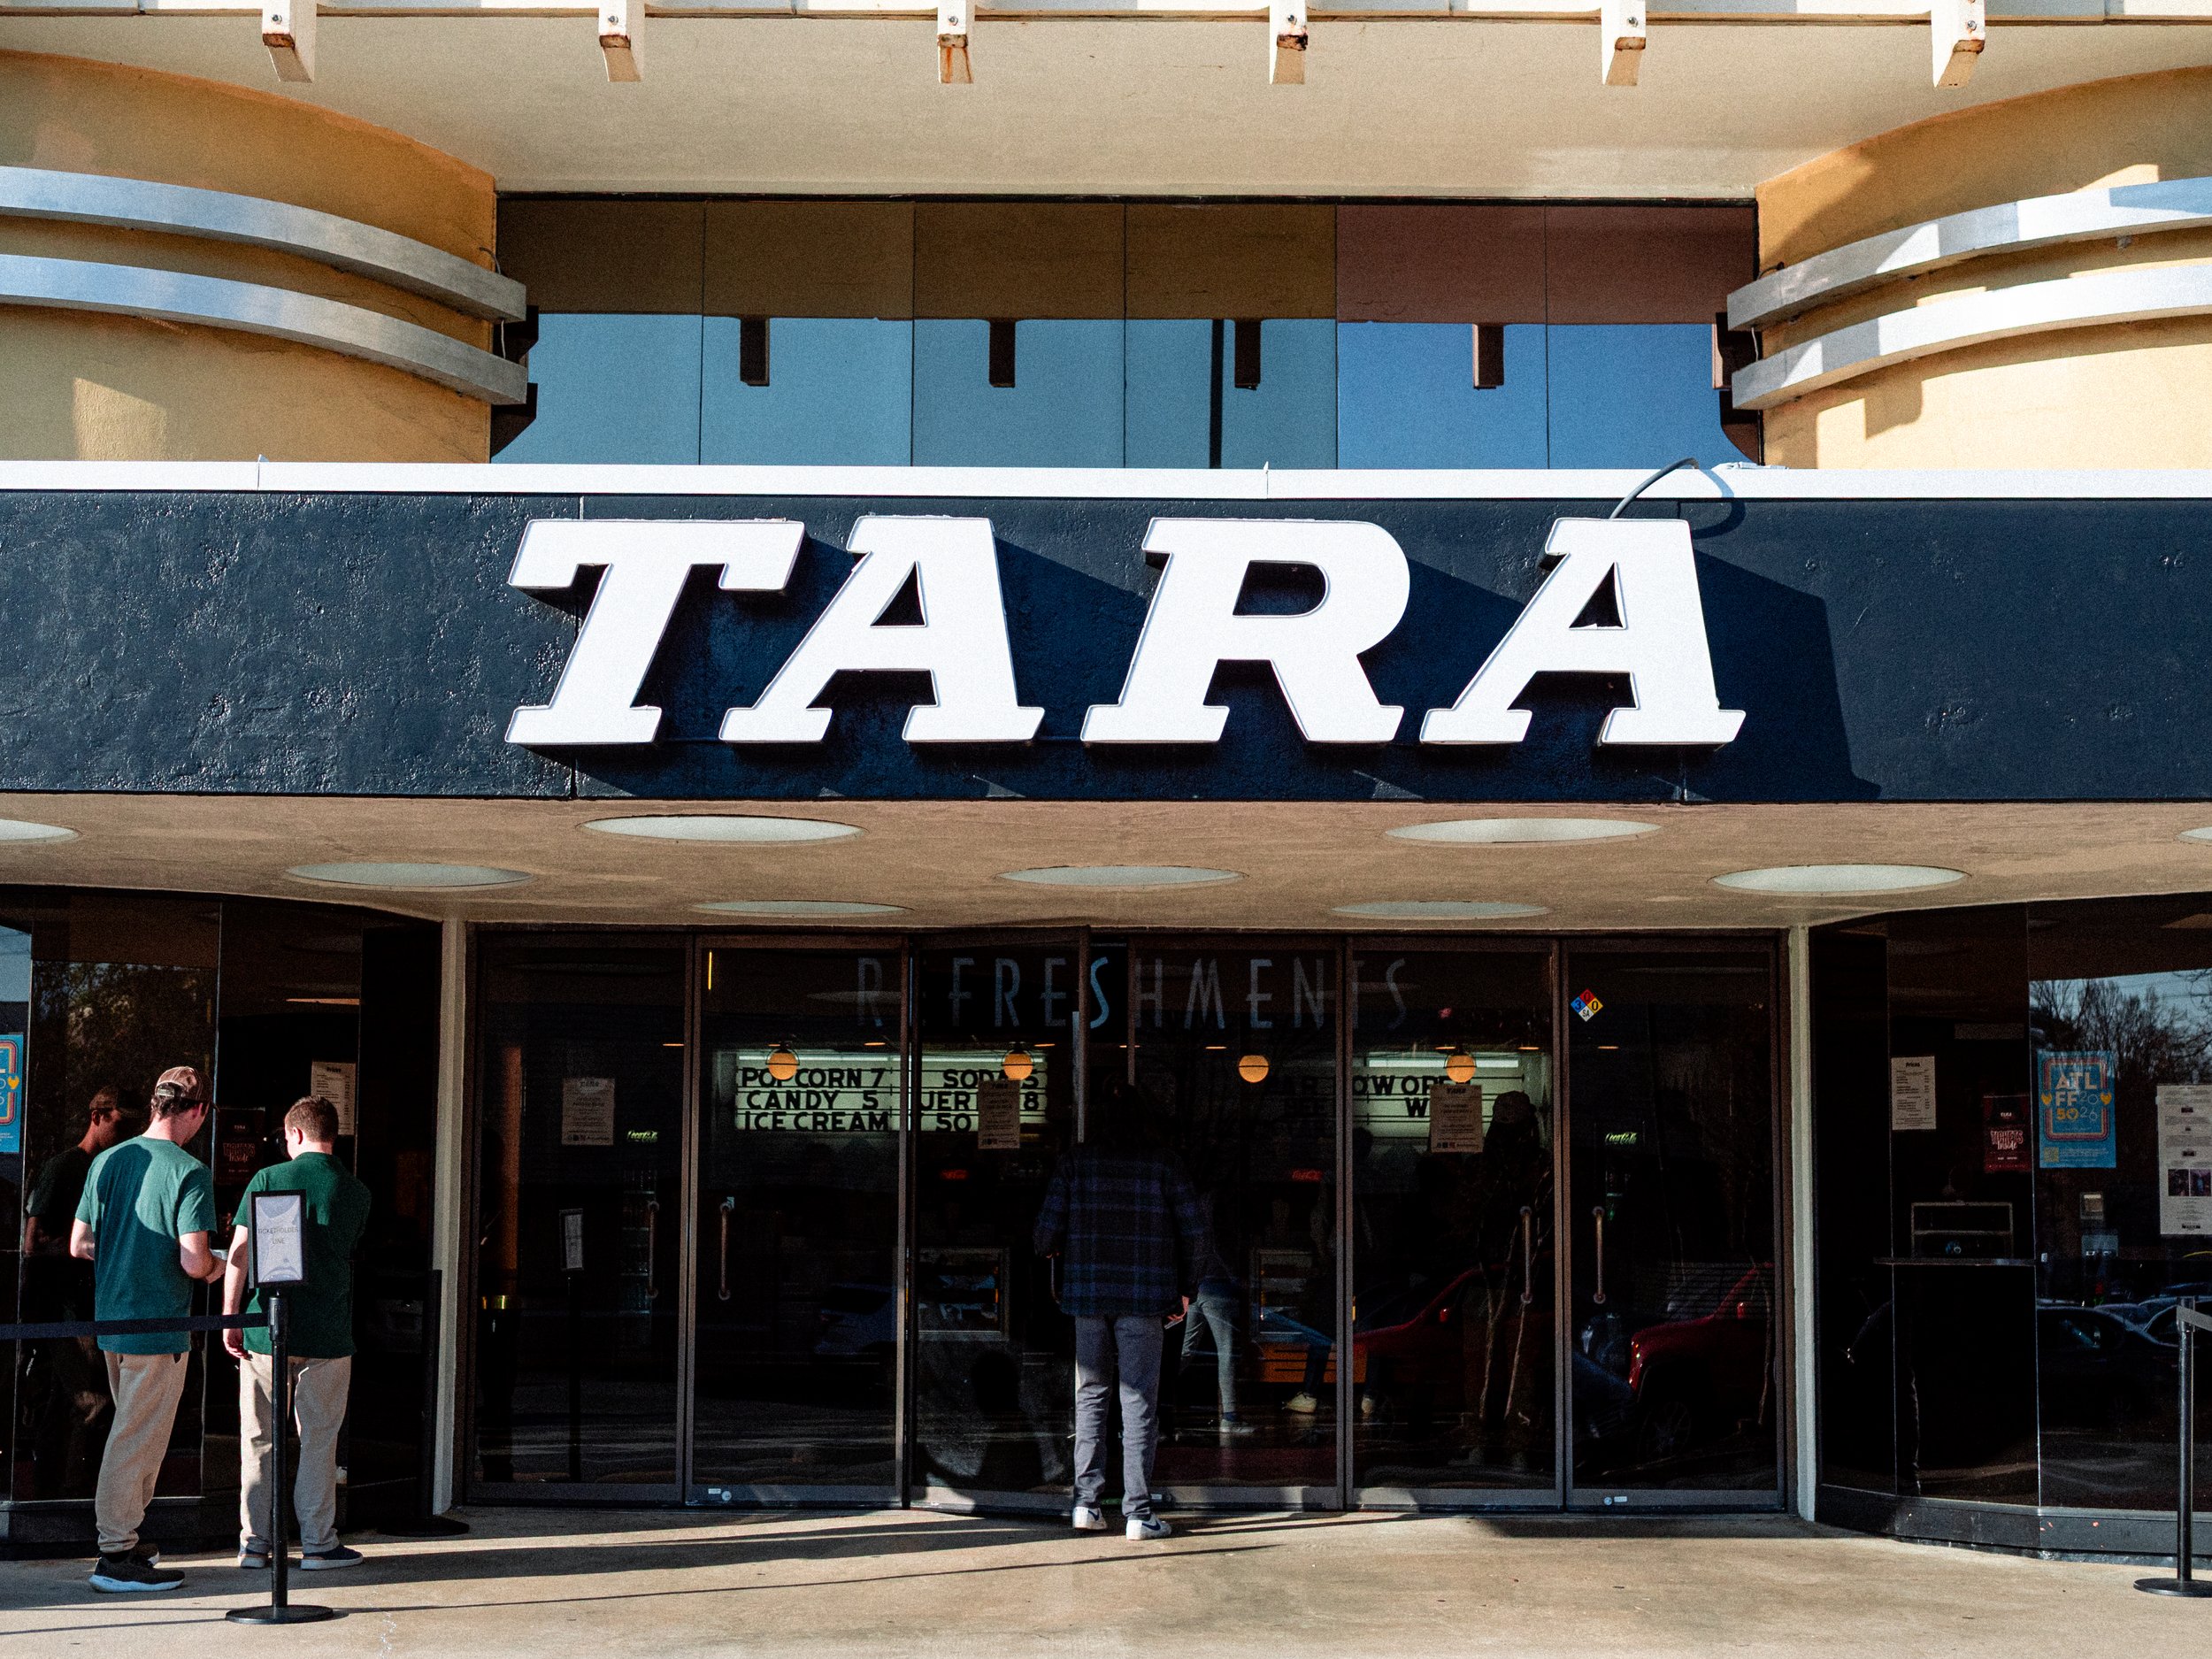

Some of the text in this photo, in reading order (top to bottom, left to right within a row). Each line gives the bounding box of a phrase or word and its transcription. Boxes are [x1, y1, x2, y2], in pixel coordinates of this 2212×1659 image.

[504, 516, 1746, 749] TARA
[1575, 1000, 1599, 1010] 3 0
[871, 1068, 886, 1088] 7
[943, 1069, 1040, 1089] SODS
[2055, 1071, 2098, 1089] ATL
[746, 1090, 879, 1110] CANDY 5
[1024, 1091, 1039, 1111] 8
[2055, 1090, 2098, 1106] FF 20
[744, 1111, 888, 1132] ICE CREAM
[2056, 1106, 2098, 1121] 50 26
